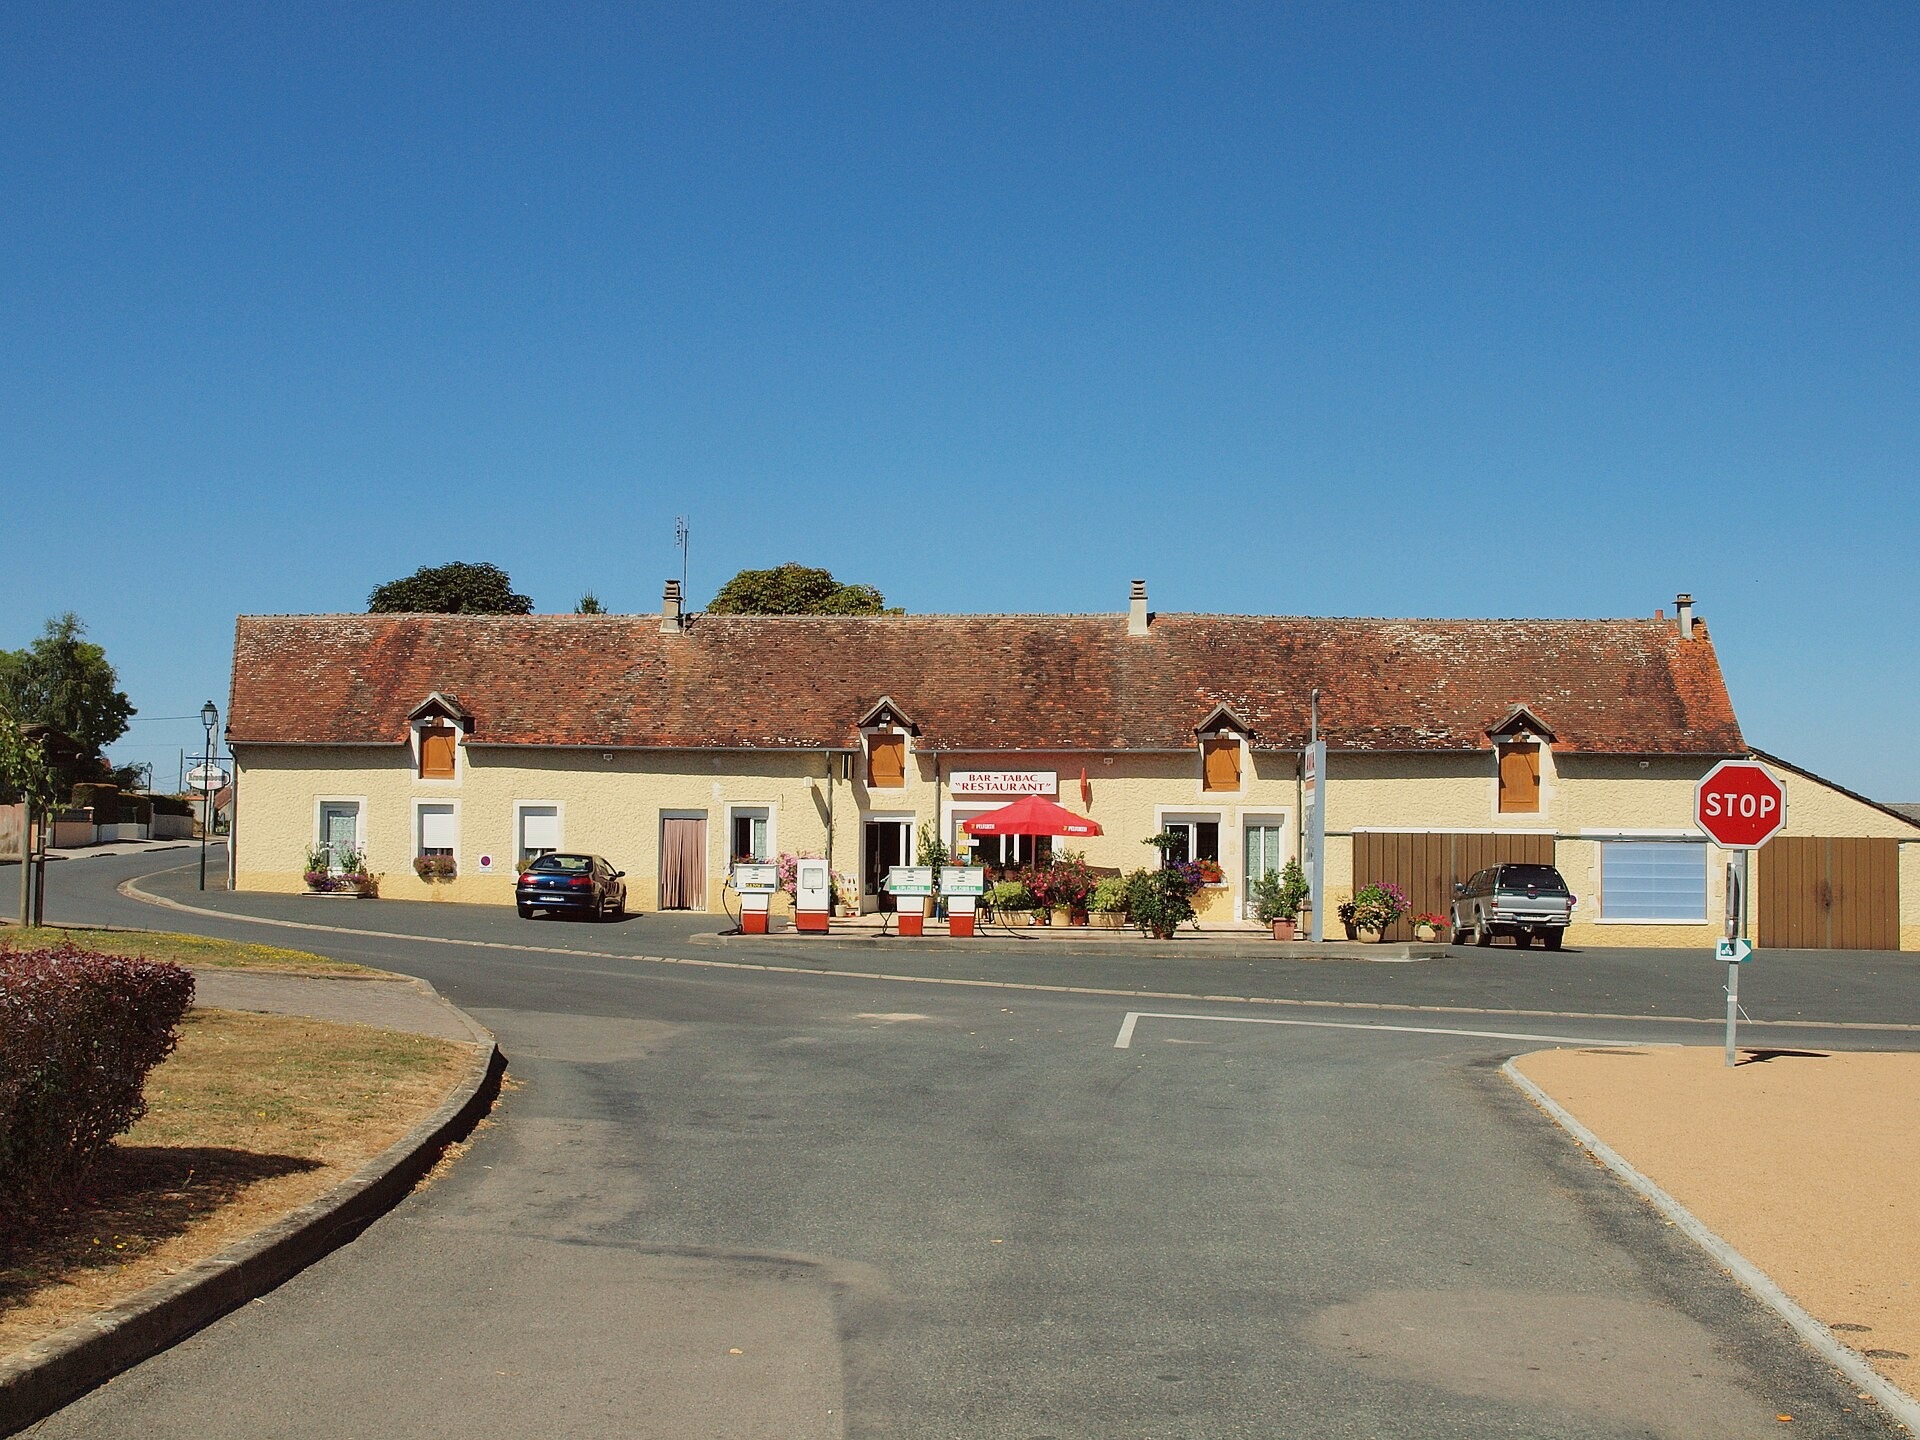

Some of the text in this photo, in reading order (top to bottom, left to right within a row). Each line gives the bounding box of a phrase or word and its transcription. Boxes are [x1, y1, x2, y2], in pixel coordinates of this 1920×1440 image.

[969, 774, 991, 782] BAR
[1001, 774, 1038, 782] TABAC
[1705, 792, 1776, 819] STOP
